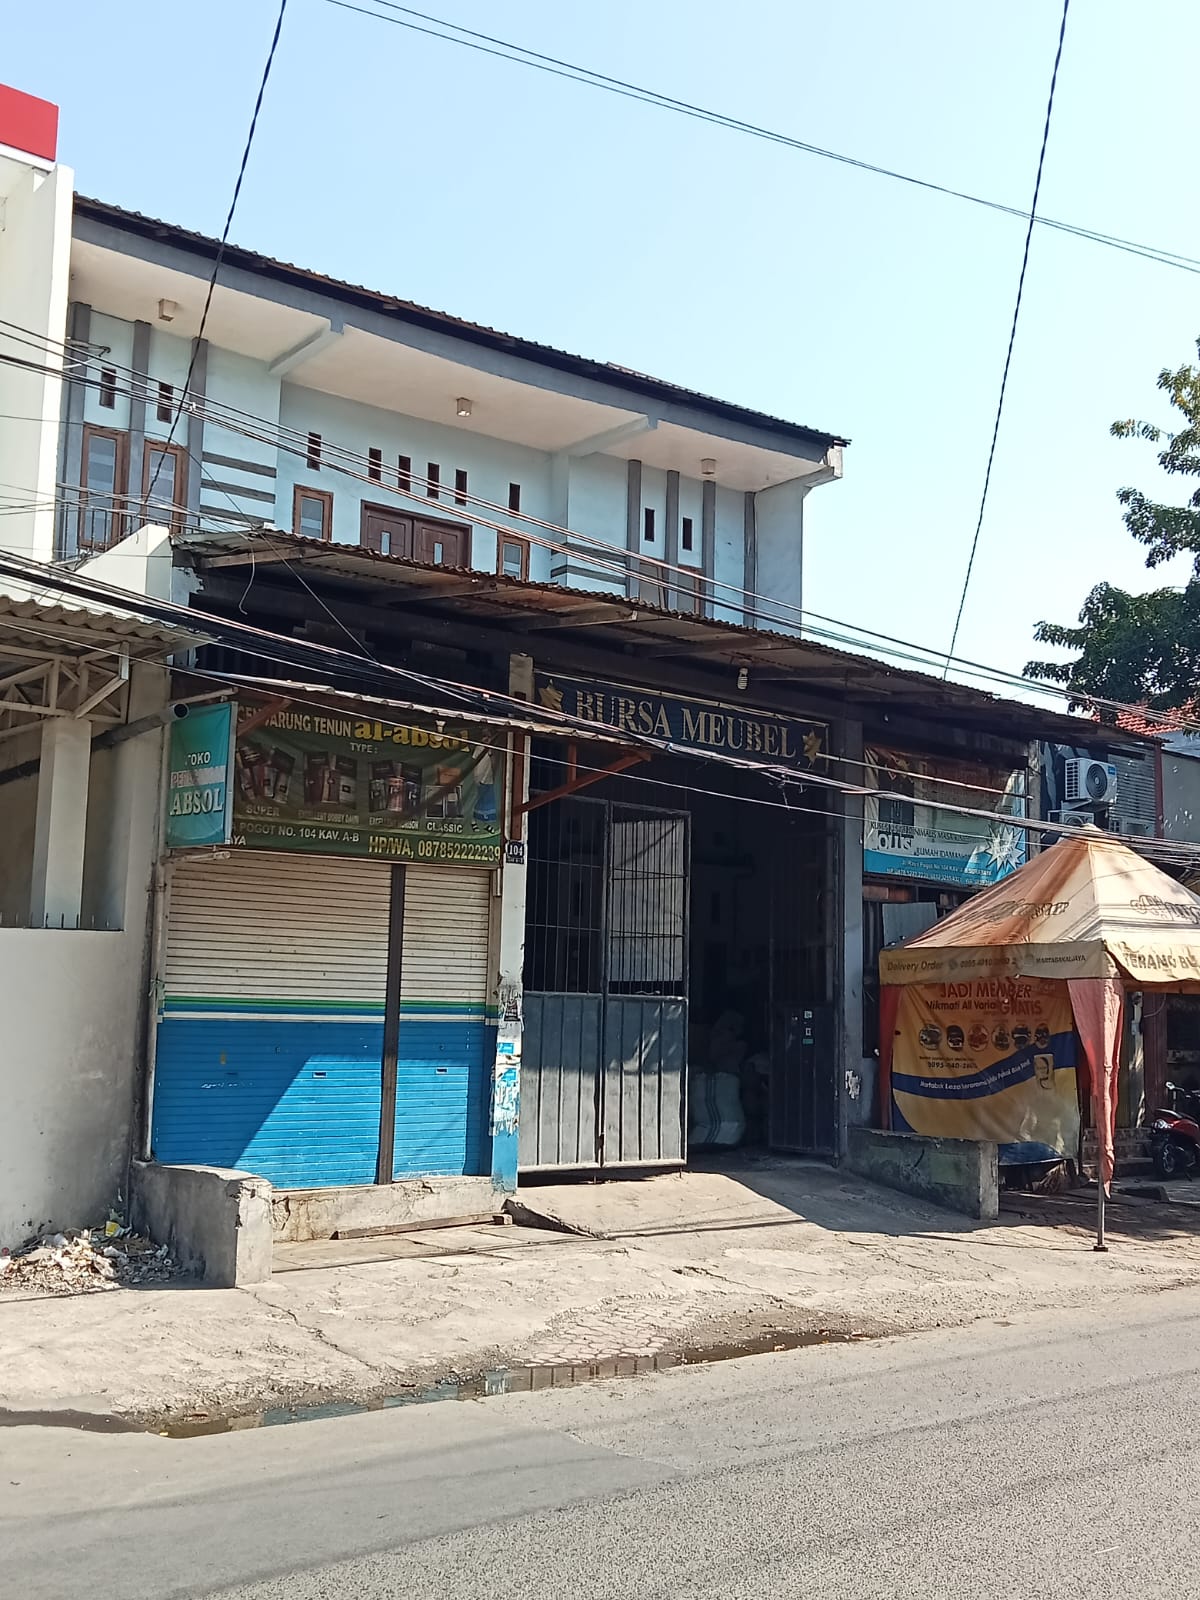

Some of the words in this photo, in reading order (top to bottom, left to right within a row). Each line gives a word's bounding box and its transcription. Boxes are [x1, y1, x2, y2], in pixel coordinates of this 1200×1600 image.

[264, 711, 312, 732] ARUNG
[314, 716, 352, 738] TENUN
[576, 689, 672, 739] BURSA
[681, 707, 796, 758] MEUBEL
[350, 742, 373, 753] TYPE
[169, 788, 223, 816] ABSOL
[246, 803, 280, 817] SUPER
[239, 822, 277, 837] POGOT
[278, 826, 297, 838] NO.
[299, 828, 316, 839] 104
[318, 830, 341, 842] KAV.
[343, 831, 360, 843] A-B
[426, 821, 463, 833] CLASSIC
[232, 836, 247, 847] YA
[368, 836, 414, 859] HP/WA,
[509, 844, 523, 856] 104
[887, 961, 920, 973] Delivery
[940, 982, 972, 998] JADI
[961, 1000, 972, 1010] All
[974, 1001, 996, 1011] Varia
[999, 999, 1042, 1016] GRATIS
